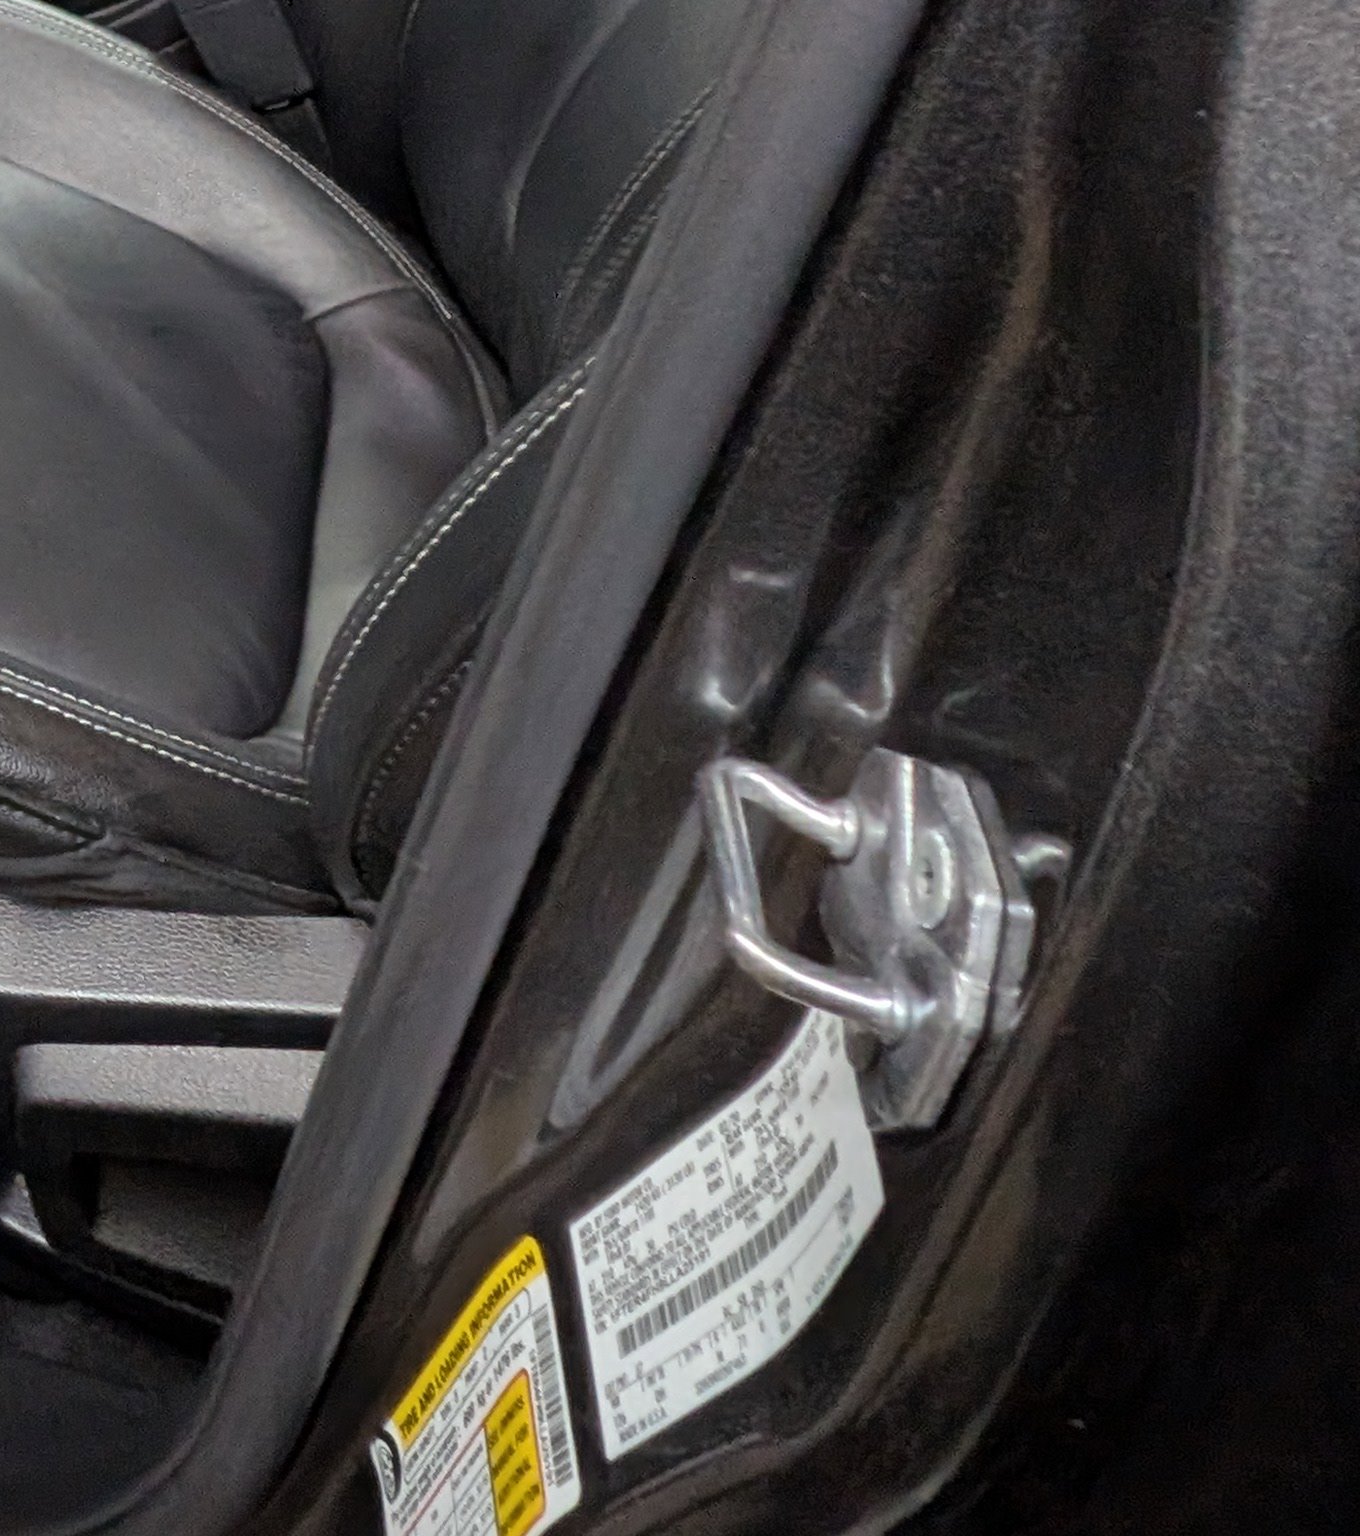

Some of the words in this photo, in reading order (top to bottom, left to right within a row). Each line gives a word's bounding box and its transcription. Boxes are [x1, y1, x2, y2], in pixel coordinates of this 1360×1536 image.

[398, 1405, 420, 1440] TIRE
[418, 1382, 436, 1417] AND
[434, 1331, 471, 1389] LOADING
[468, 1251, 537, 1340] INFORMATION
